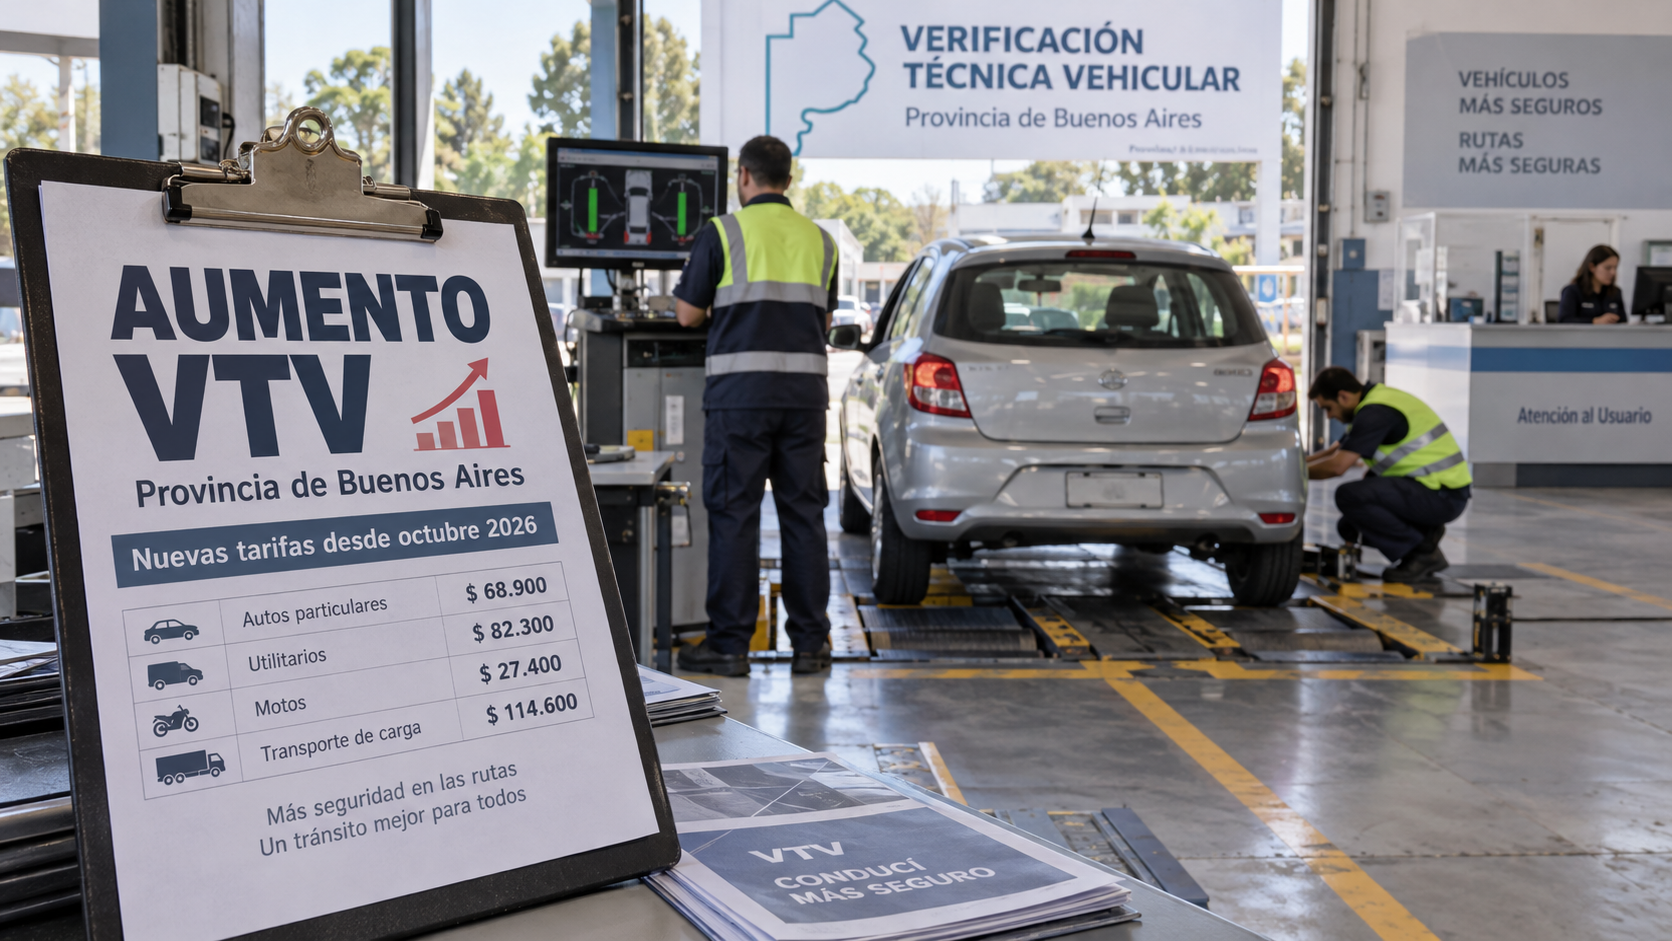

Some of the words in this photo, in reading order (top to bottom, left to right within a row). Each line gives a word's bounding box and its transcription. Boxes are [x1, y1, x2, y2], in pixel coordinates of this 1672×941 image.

[900, 21, 1143, 55] VERIFICACIÓN
[902, 55, 1053, 90] TÉCNICA
[1062, 64, 1240, 92] VEHICULAR
[1458, 67, 1570, 89] VEHÍCULOS
[905, 106, 1011, 128] Provincia
[1018, 107, 1047, 128] de
[1054, 107, 1138, 129] Buenos
[1144, 108, 1203, 129] Aires
[1459, 93, 1504, 115] MÁS
[1510, 97, 1603, 116] SEGUROS
[1459, 131, 1524, 149] RUTAS
[1458, 152, 1504, 174] MÁS
[1510, 156, 1602, 175] SEGURAS
[110, 264, 491, 344] AUMENTO
[112, 353, 372, 462] VTV
[1517, 406, 1579, 425] Atención
[1581, 406, 1594, 425] al
[1597, 406, 1653, 425] Usuario
[135, 472, 281, 508] Provincia
[291, 470, 327, 499] de
[337, 469, 445, 496] Buenos
[454, 462, 525, 489] Aires
[131, 546, 229, 572] Nuevas
[236, 535, 315, 562] tarifas
[323, 528, 391, 554] desde
[398, 521, 480, 546] octubre
[485, 515, 538, 538] 2026
[242, 610, 290, 628] Autos
[295, 598, 388, 625] particulares
[465, 582, 478, 604] $
[483, 576, 547, 600] 68.900
[248, 648, 327, 672] Utilitarios
[472, 622, 485, 644] $
[490, 615, 554, 640] 82.300
[254, 697, 307, 717] Motos
[479, 663, 492, 685] $
[497, 654, 562, 681] 27.400
[260, 734, 350, 762] Transporte
[354, 728, 374, 745] de
[379, 722, 422, 741] carga
[486, 704, 499, 726] $
[504, 692, 578, 722] 114.600
[266, 802, 307, 826] Más
[314, 782, 406, 817] seguridad
[411, 779, 434, 798] en
[439, 772, 466, 792] las
[471, 762, 518, 786] rutas
[259, 836, 287, 857] Un
[293, 821, 368, 850] tránsito
[373, 809, 425, 833] mejor
[432, 800, 472, 825] para
[476, 787, 527, 811] todos
[748, 841, 845, 864] VTV
[774, 857, 927, 890] CONDUCÍ
[788, 883, 866, 905] MÁS
[867, 866, 996, 897] SEGURO
